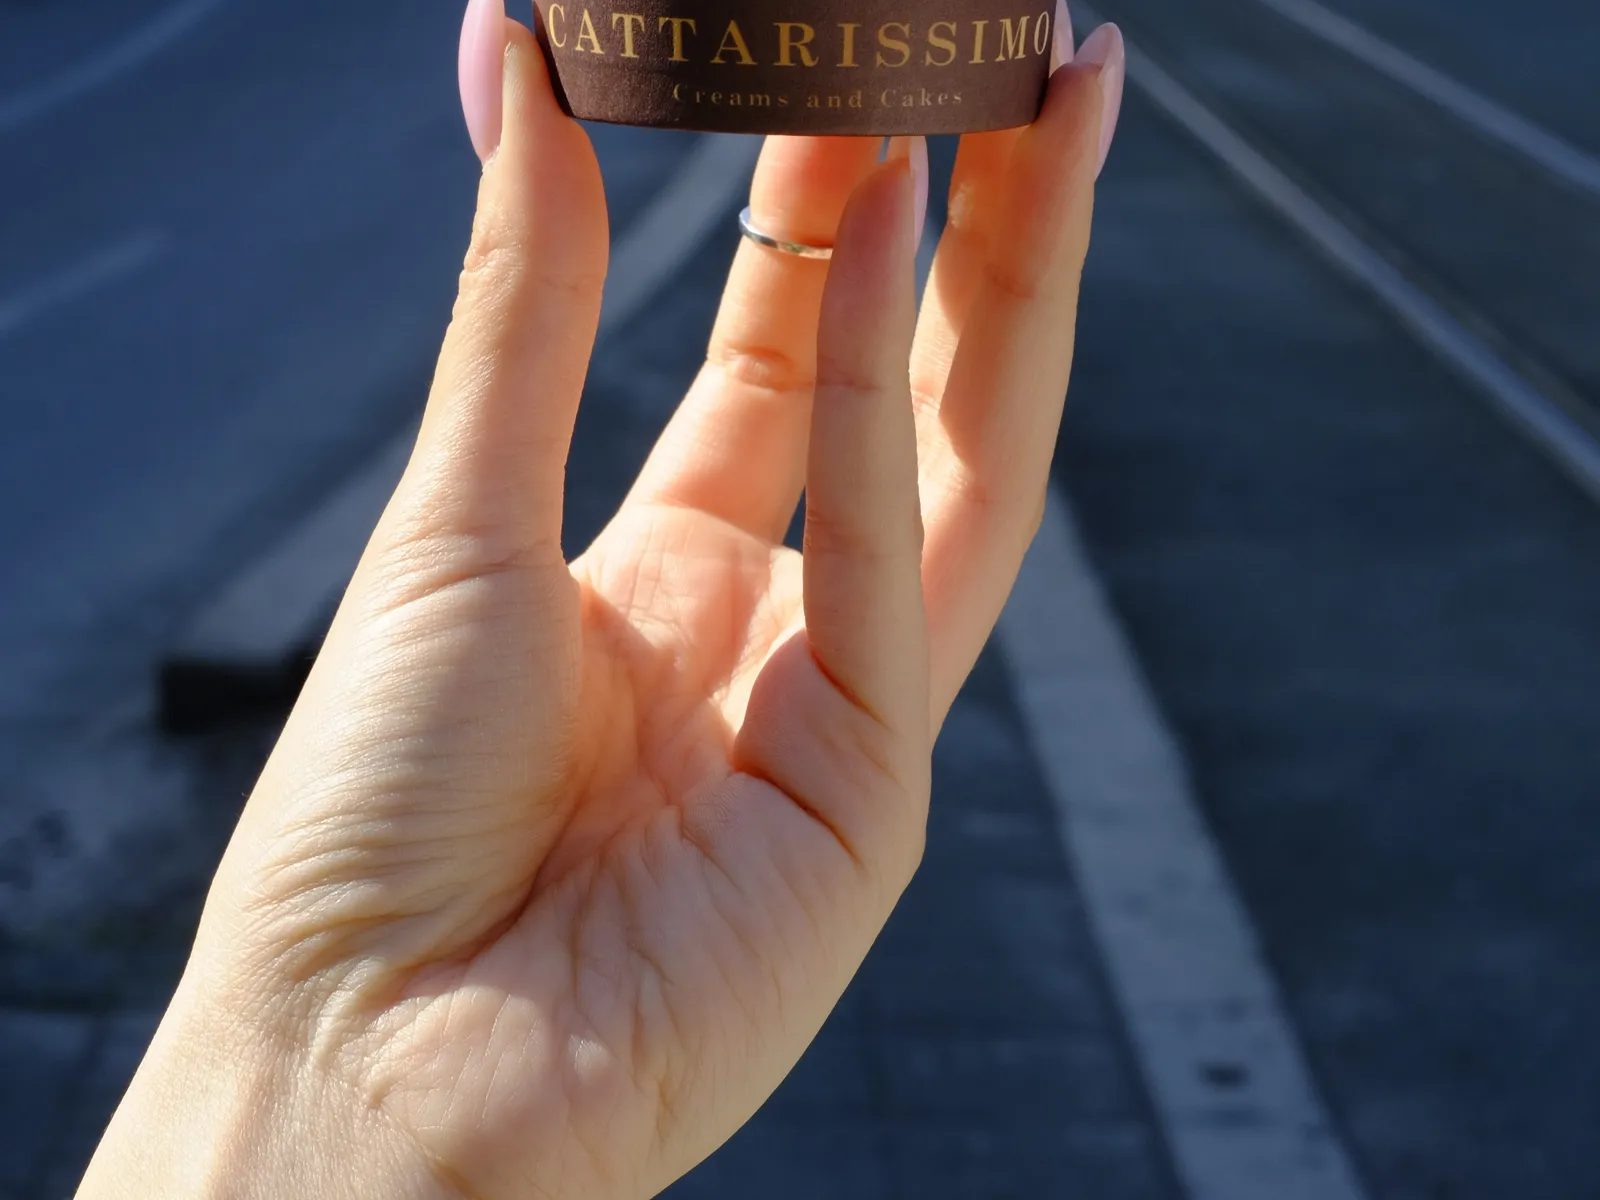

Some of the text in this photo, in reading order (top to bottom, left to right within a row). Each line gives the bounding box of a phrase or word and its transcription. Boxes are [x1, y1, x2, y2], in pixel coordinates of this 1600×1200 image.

[548, 2, 1051, 68] CATTARISSIMO
[673, 83, 963, 108] Creams and Cakes
